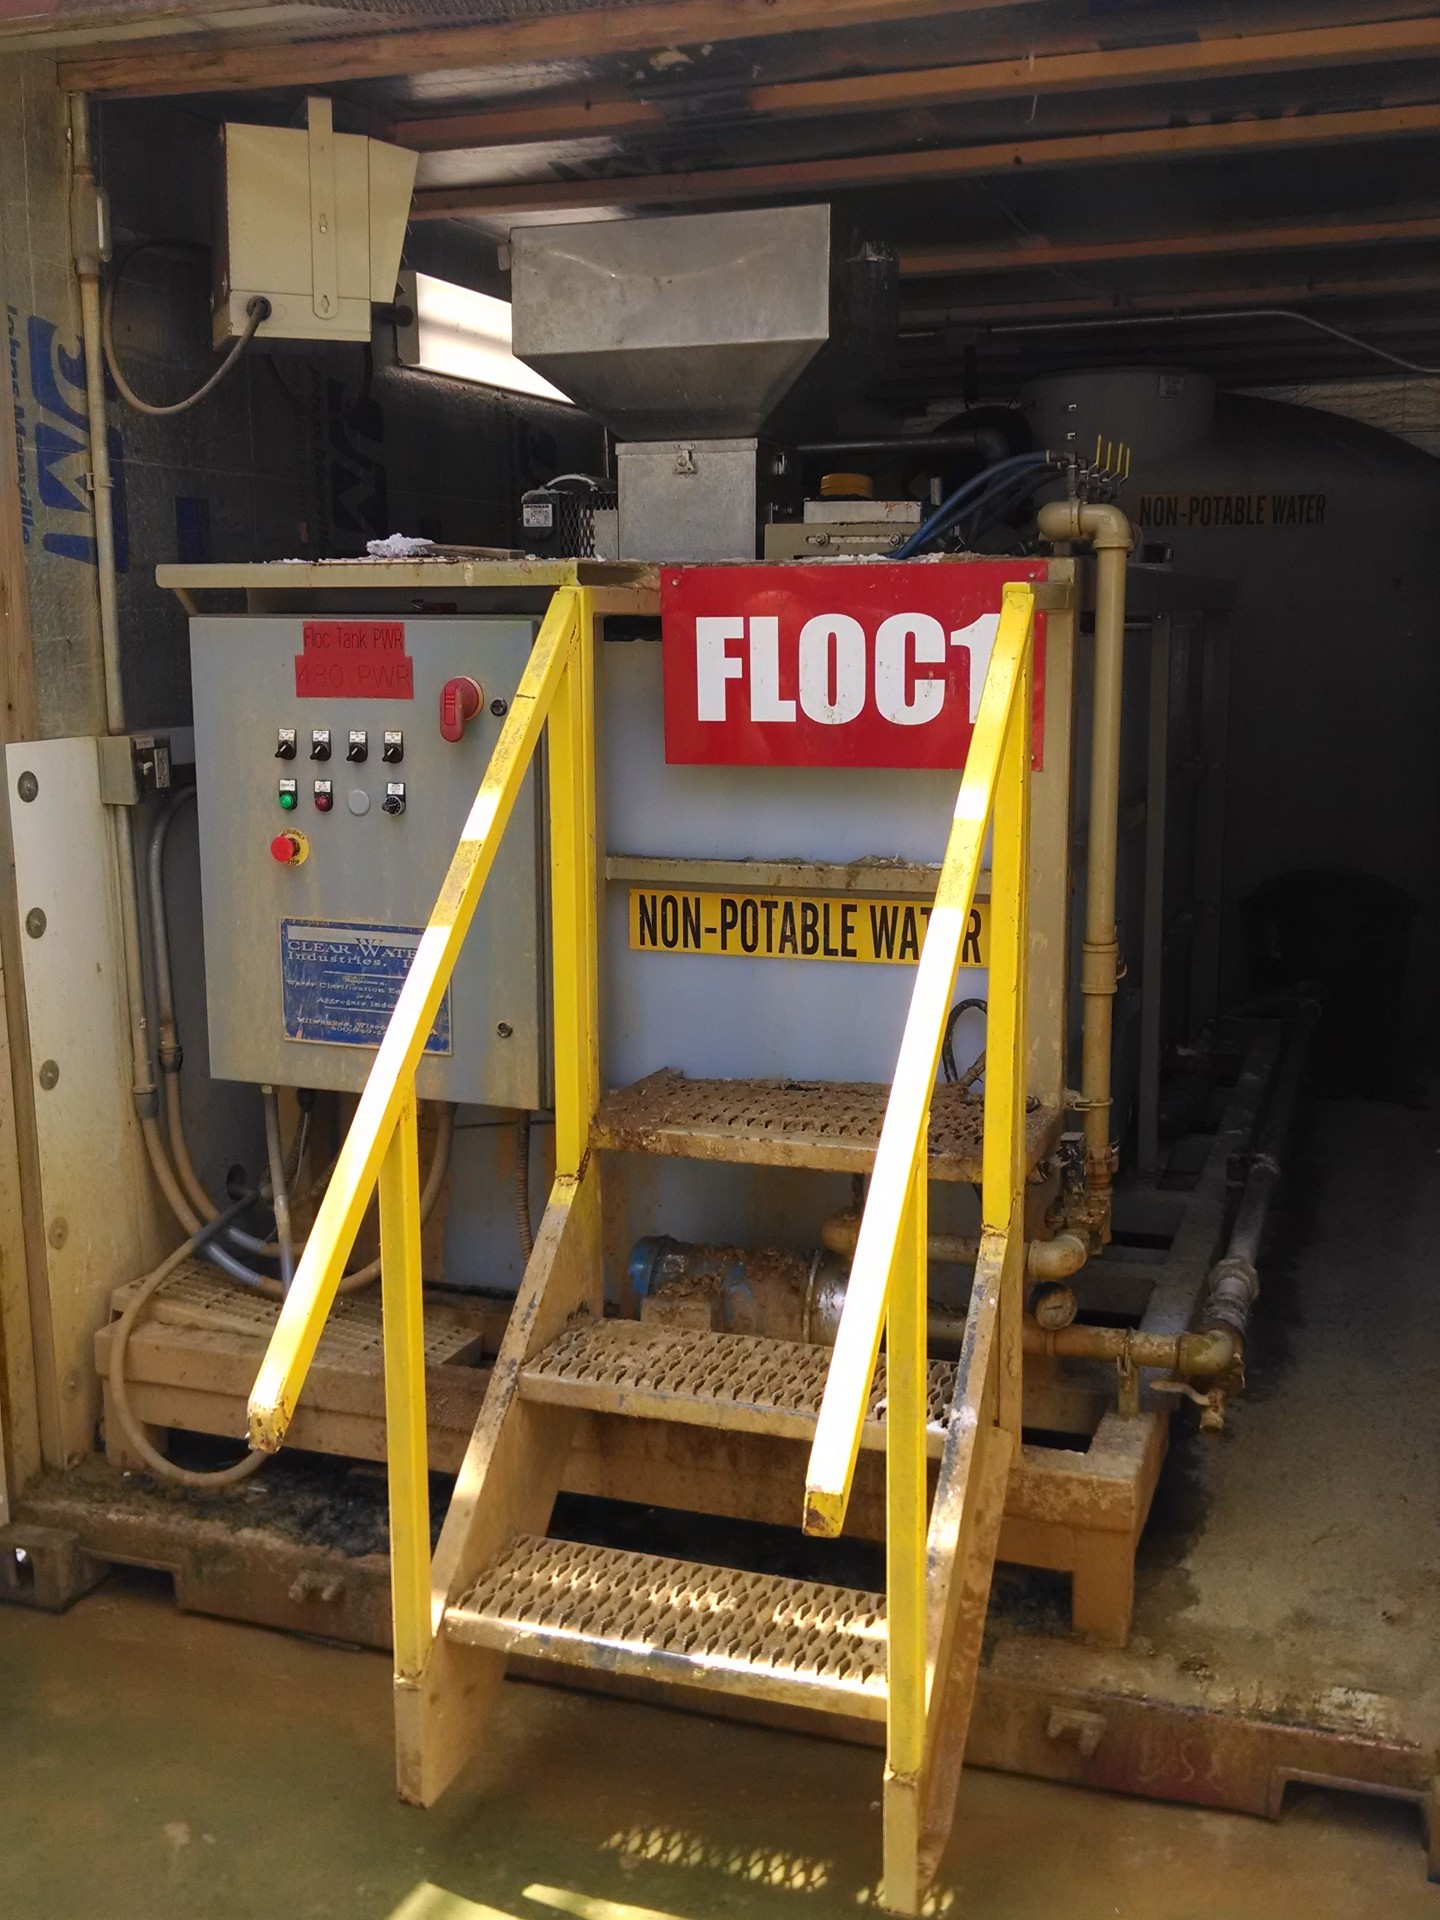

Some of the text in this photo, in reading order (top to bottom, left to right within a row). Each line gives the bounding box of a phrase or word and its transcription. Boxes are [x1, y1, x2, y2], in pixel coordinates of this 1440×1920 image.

[1140, 495, 1326, 526] NON-POTABLE WATER
[304, 628, 402, 649] Floc Tank PWR
[358, 665, 410, 688] PWR
[696, 612, 1000, 725] FLOC1
[639, 894, 857, 957] NON-POTABLE
[287, 937, 417, 959] CLEAR WATE
